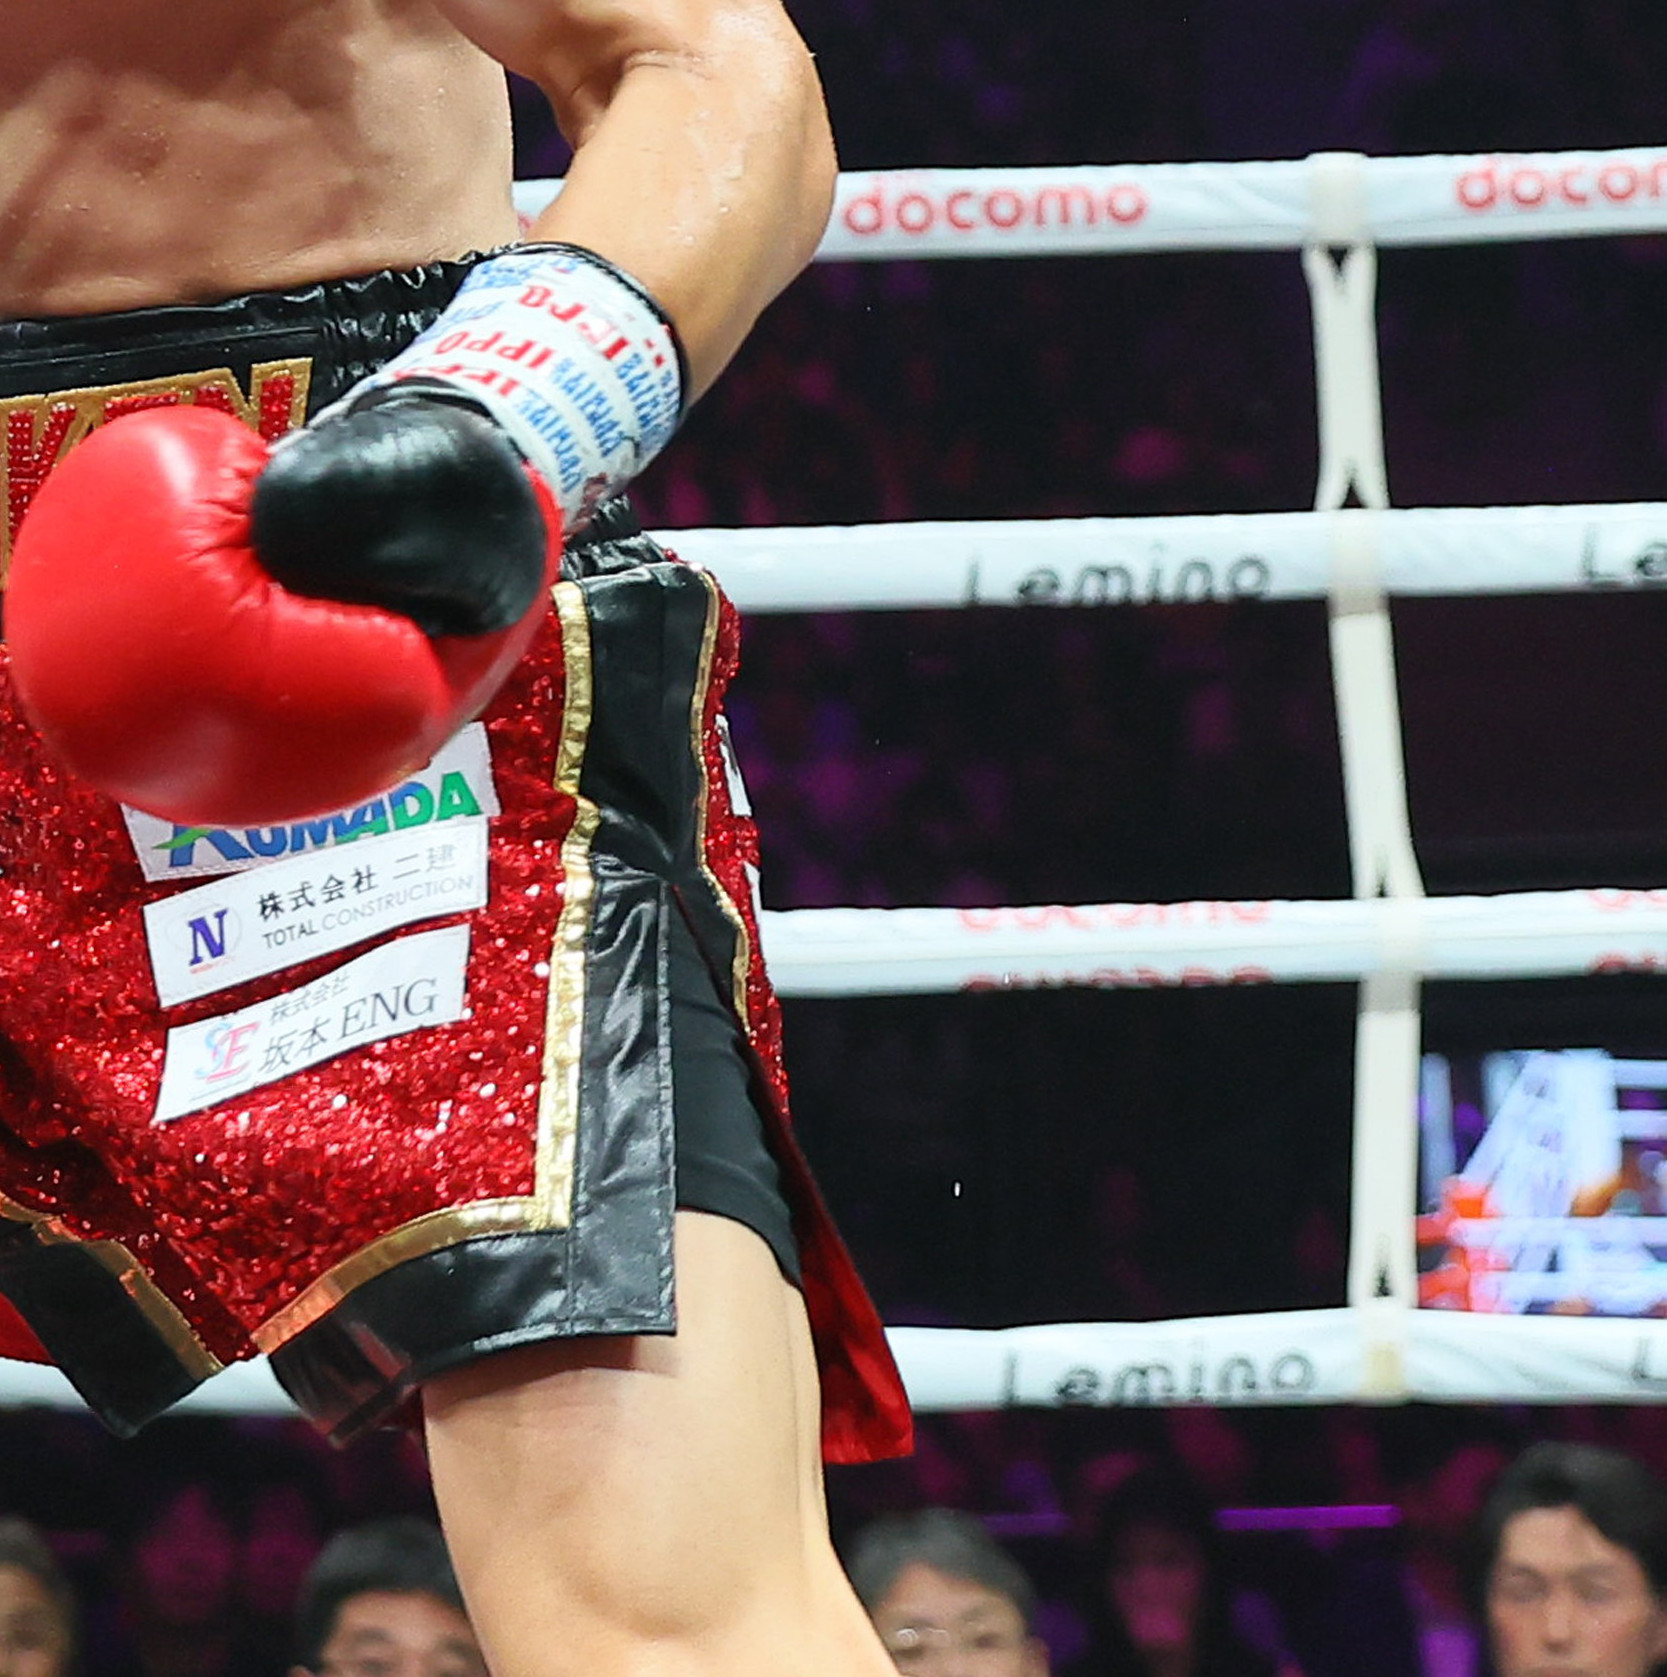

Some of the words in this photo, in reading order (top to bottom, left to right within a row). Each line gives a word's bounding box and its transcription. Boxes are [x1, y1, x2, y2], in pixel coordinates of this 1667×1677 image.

[840, 169, 1150, 236] docomo
[1455, 156, 1667, 214] doco
[257, 865, 379, 924] 株式会社
[261, 918, 320, 951] TOTAL
[321, 873, 476, 934] CONSTRUCTION
[187, 908, 230, 967] N
[337, 976, 440, 1042] ENG
[1000, 1346, 1316, 1410] Lemino
